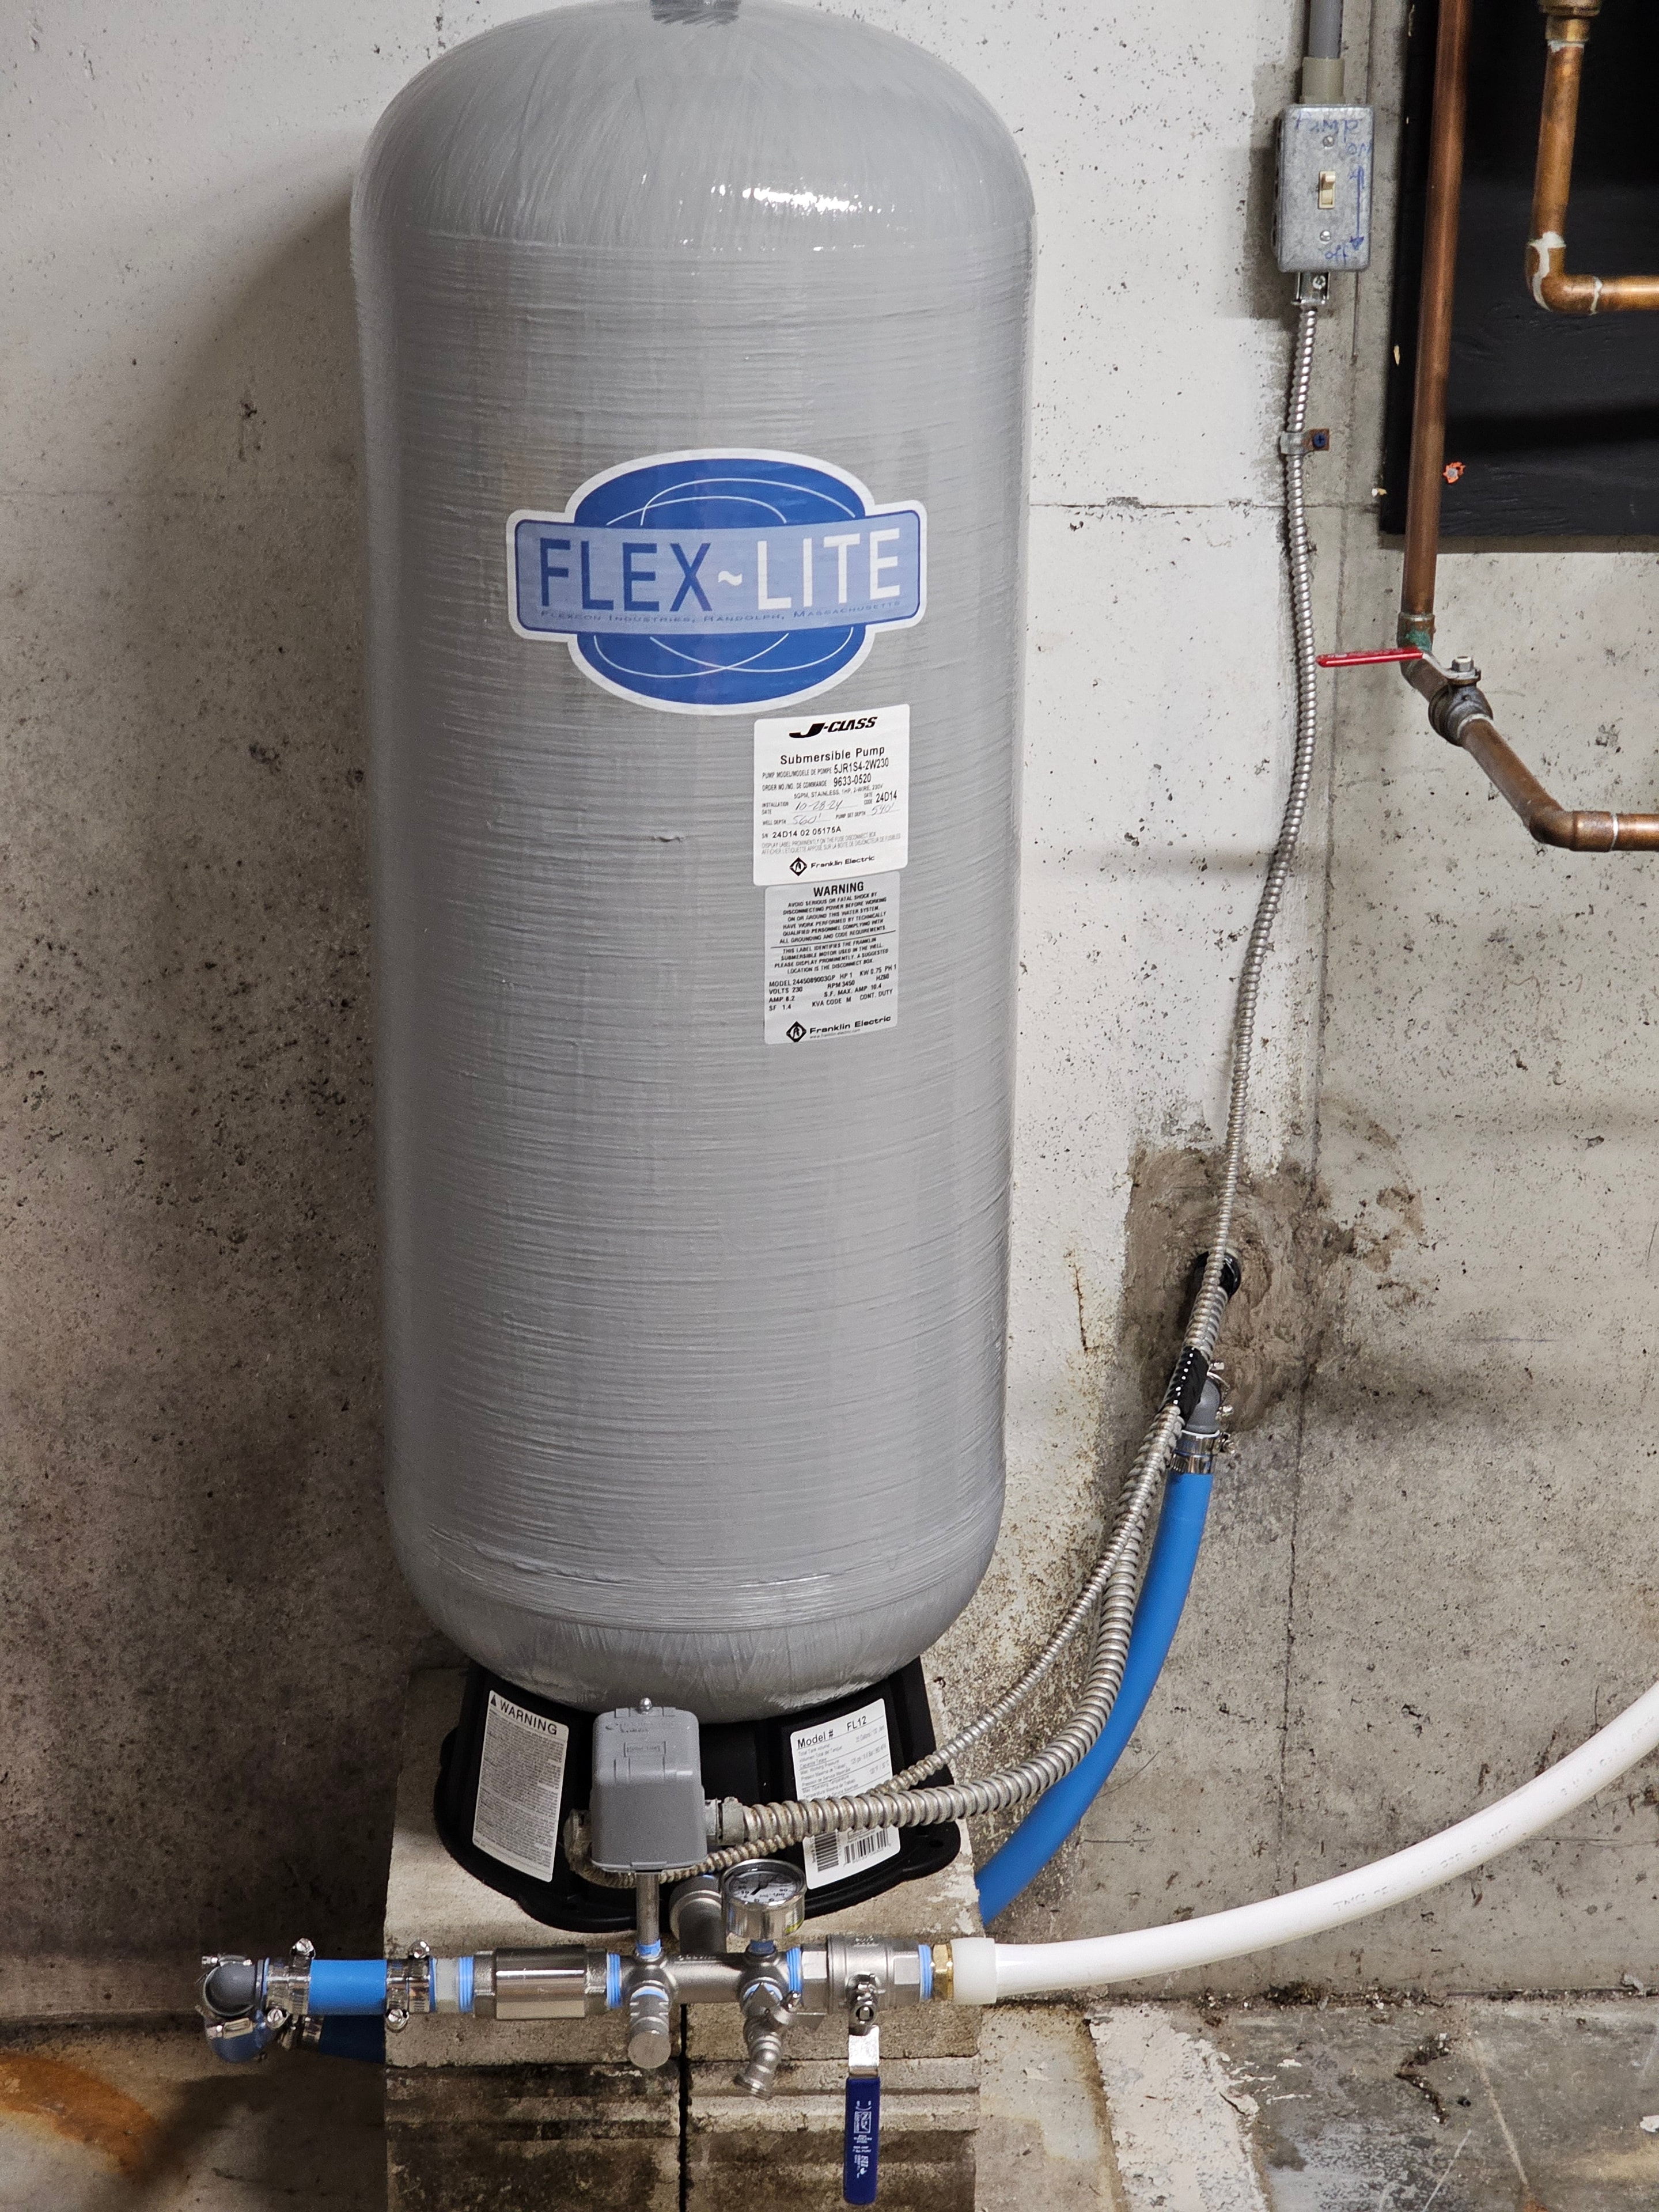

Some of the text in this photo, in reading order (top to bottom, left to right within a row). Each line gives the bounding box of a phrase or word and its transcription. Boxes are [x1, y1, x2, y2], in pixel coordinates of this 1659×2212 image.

[789, 716, 878, 738] J-CLASS
[781, 747, 885, 764] Submersible Pump
[834, 773, 872, 787] 9633-0520
[876, 790, 897, 803] 24D14
[772, 830, 797, 838] 24D14
[811, 855, 875, 869] Franklin Electric
[813, 881, 864, 897] WARNING
[816, 918, 846, 926] PERFORMED
[791, 934, 821, 942] GROUNDING
[853, 937, 877, 945] FRANKLIN
[781, 953, 817, 961] SUBMERSIBLE
[862, 948, 889, 957] SUGGESTED
[878, 988, 893, 997] DUTY
[810, 1016, 892, 1034] Franklin Electric
[500, 1700, 557, 1735] WARNING
[797, 1732, 826, 1749] Model
[847, 1715, 867, 1732] FL12
